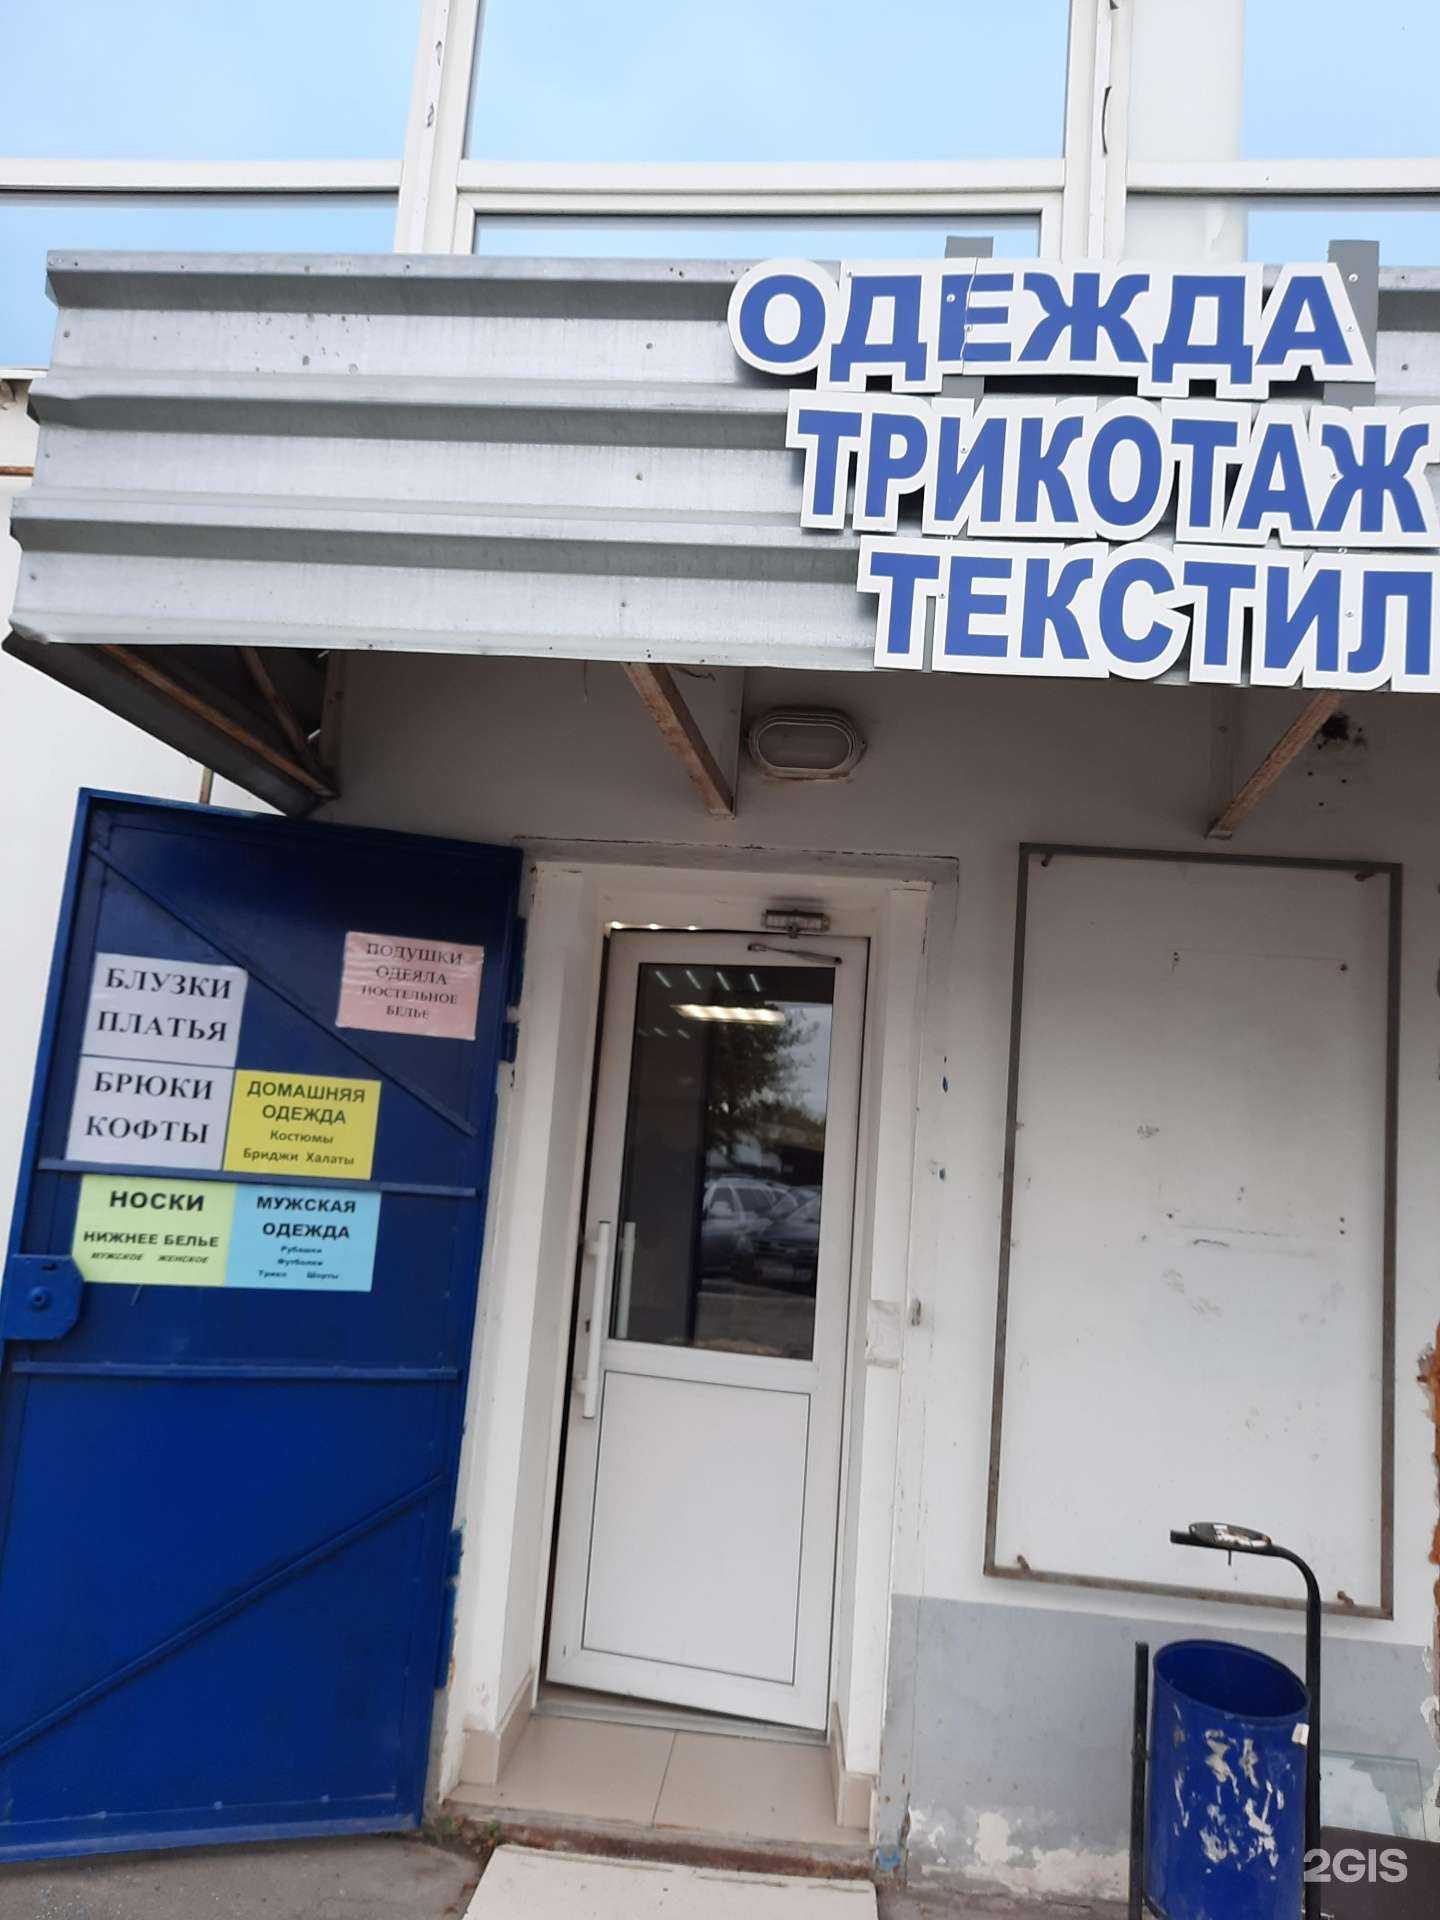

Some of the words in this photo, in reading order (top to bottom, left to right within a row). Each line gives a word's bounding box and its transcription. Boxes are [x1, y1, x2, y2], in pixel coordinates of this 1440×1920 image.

[739, 272, 1353, 384] ОДЕЖДА
[796, 409, 1429, 533] ТРИКОТАЖ
[869, 551, 1433, 676] ТЕКСТИЛ
[366, 942, 464, 966] ПОДУШКИ
[105, 967, 232, 999] БЛУЗКИ
[375, 965, 447, 985] ОДЕЯЛА
[97, 1010, 228, 1042] ПЛАТЬЯ
[94, 1071, 214, 1100] БРЮКИ
[246, 1080, 366, 1103] ДОМАШНЯЯ
[262, 1104, 347, 1125] ОДЕЖДА
[85, 1115, 210, 1144] КОФТЫ
[270, 1130, 334, 1144] Костюмы
[243, 1147, 299, 1163] Бриджи
[305, 1152, 355, 1166] Халаты
[109, 1190, 204, 1212] НОСКИ
[256, 1195, 356, 1214] МУЖСКАЯ
[83, 1230, 158, 1245] НИЖНЕЕ
[163, 1234, 219, 1248] БЕЛЬЕ
[262, 1222, 350, 1240] ОДЕЖДА
